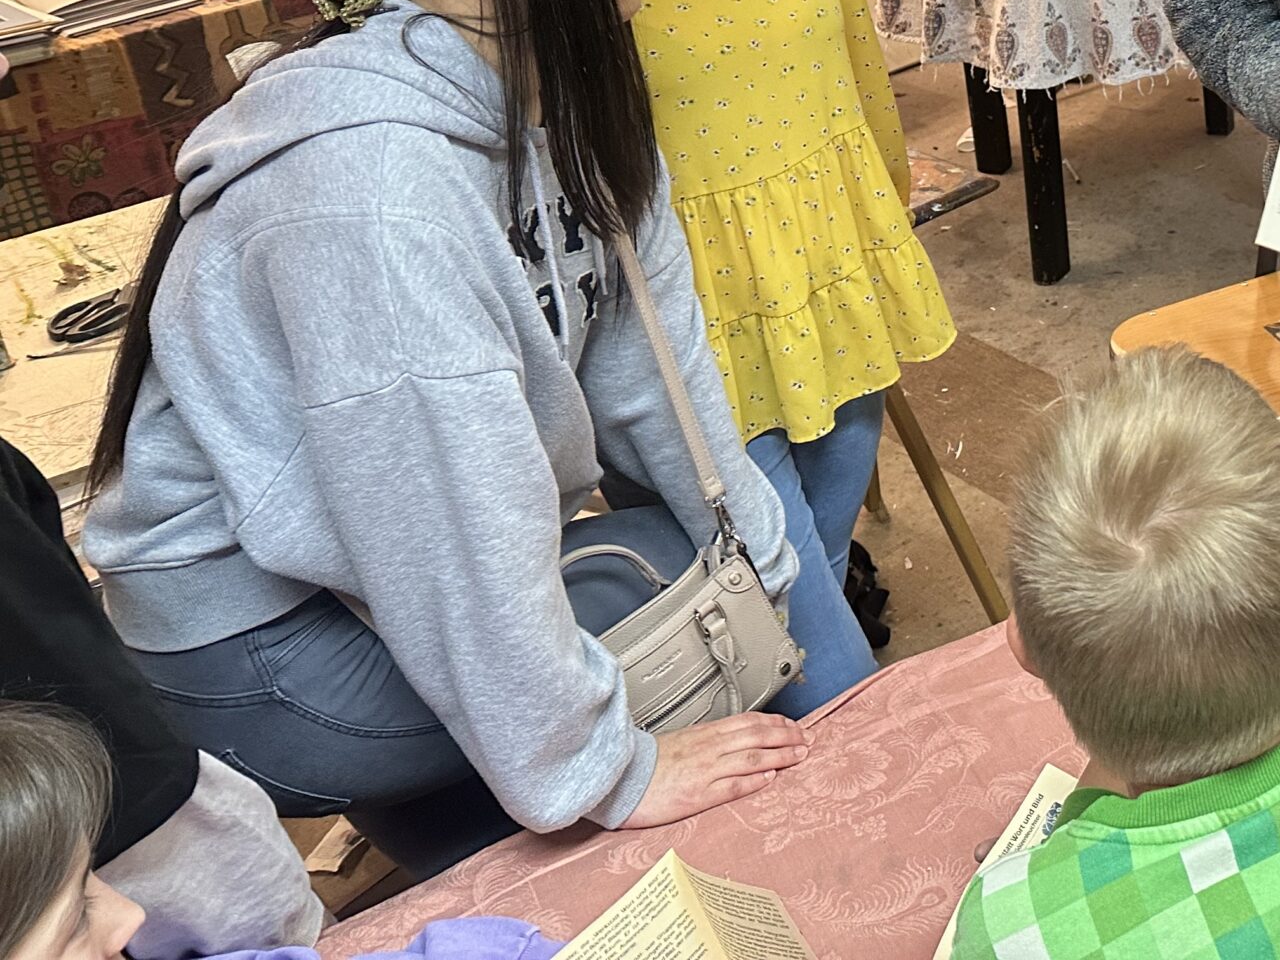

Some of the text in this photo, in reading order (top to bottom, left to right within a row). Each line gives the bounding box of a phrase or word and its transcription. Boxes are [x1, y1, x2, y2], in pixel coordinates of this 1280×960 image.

[1010, 824, 1026, 842] Wort
[1023, 808, 1035, 825] und
[1032, 793, 1044, 809] Bild
